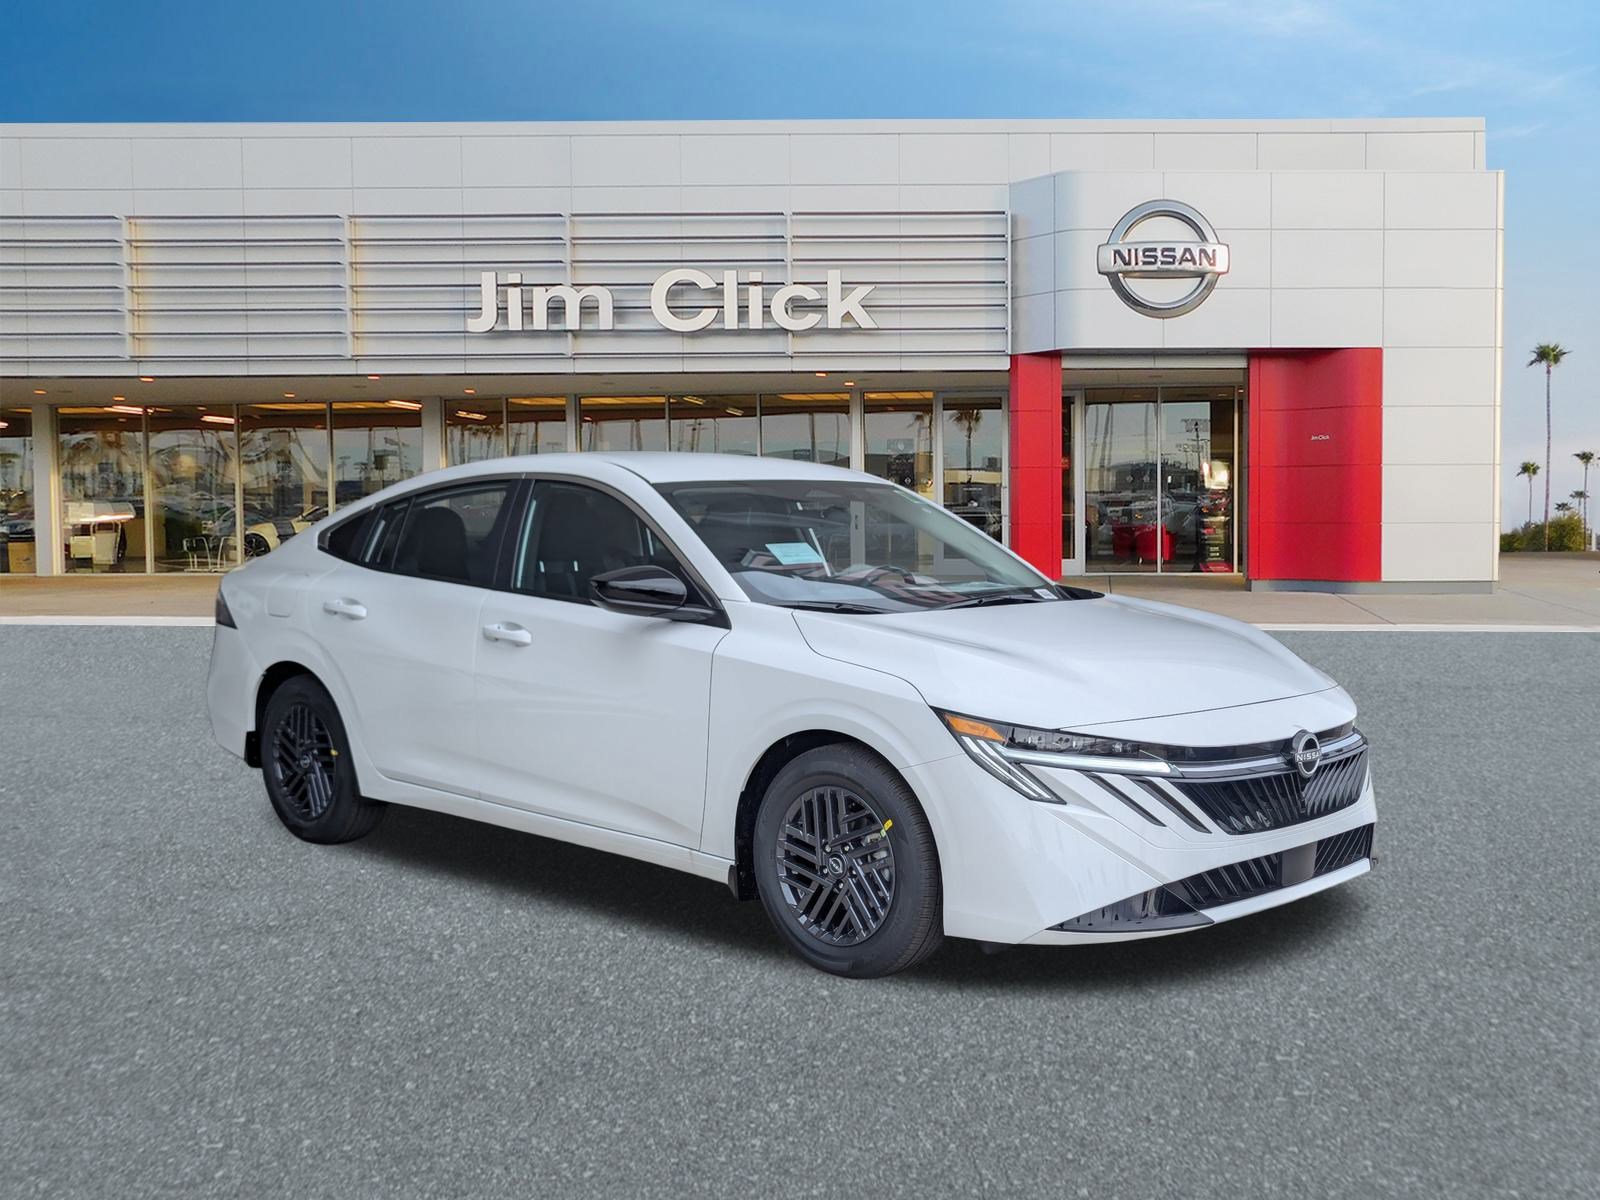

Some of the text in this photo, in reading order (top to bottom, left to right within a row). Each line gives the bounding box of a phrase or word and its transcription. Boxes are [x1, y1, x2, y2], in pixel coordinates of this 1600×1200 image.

[1112, 247, 1217, 266] NISSAN
[466, 268, 879, 333] Jim Click
[1296, 751, 1320, 762] NISSA
